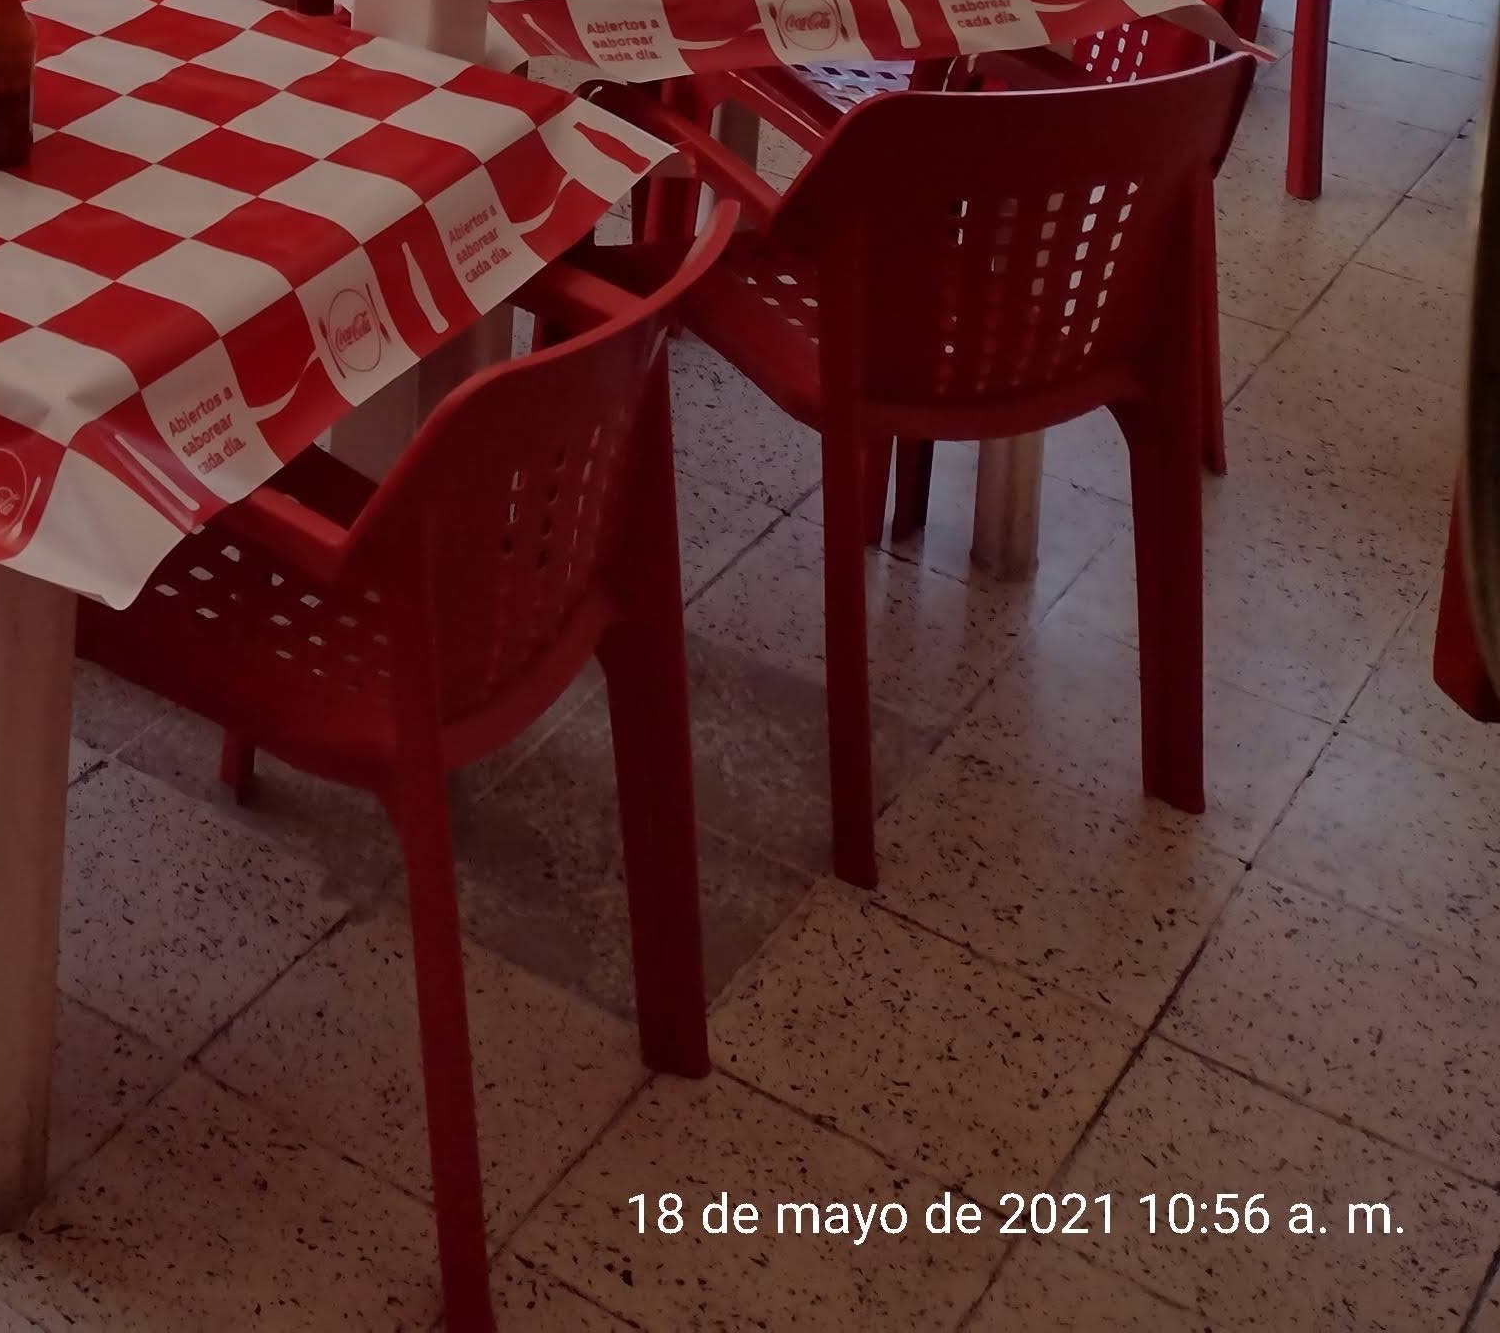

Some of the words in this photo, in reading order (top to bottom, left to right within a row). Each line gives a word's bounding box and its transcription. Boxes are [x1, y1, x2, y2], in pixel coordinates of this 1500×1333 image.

[784, 10, 834, 33] Coca-Cola
[951, 0, 1012, 17] saborear
[957, 13, 988, 29] cada
[586, 20, 646, 37] Abiertos
[651, 18, 661, 30] a
[591, 35, 655, 50] saborear
[598, 50, 630, 63] cada
[448, 209, 489, 247] Abiertos
[489, 204, 498, 218] a
[455, 226, 499, 267] saborear
[464, 256, 492, 285] cada
[335, 309, 373, 351] Coca-Cola
[168, 393, 222, 439] Abiertos
[222, 386, 234, 402] a
[181, 412, 235, 458] saborear
[197, 445, 224, 476] cada
